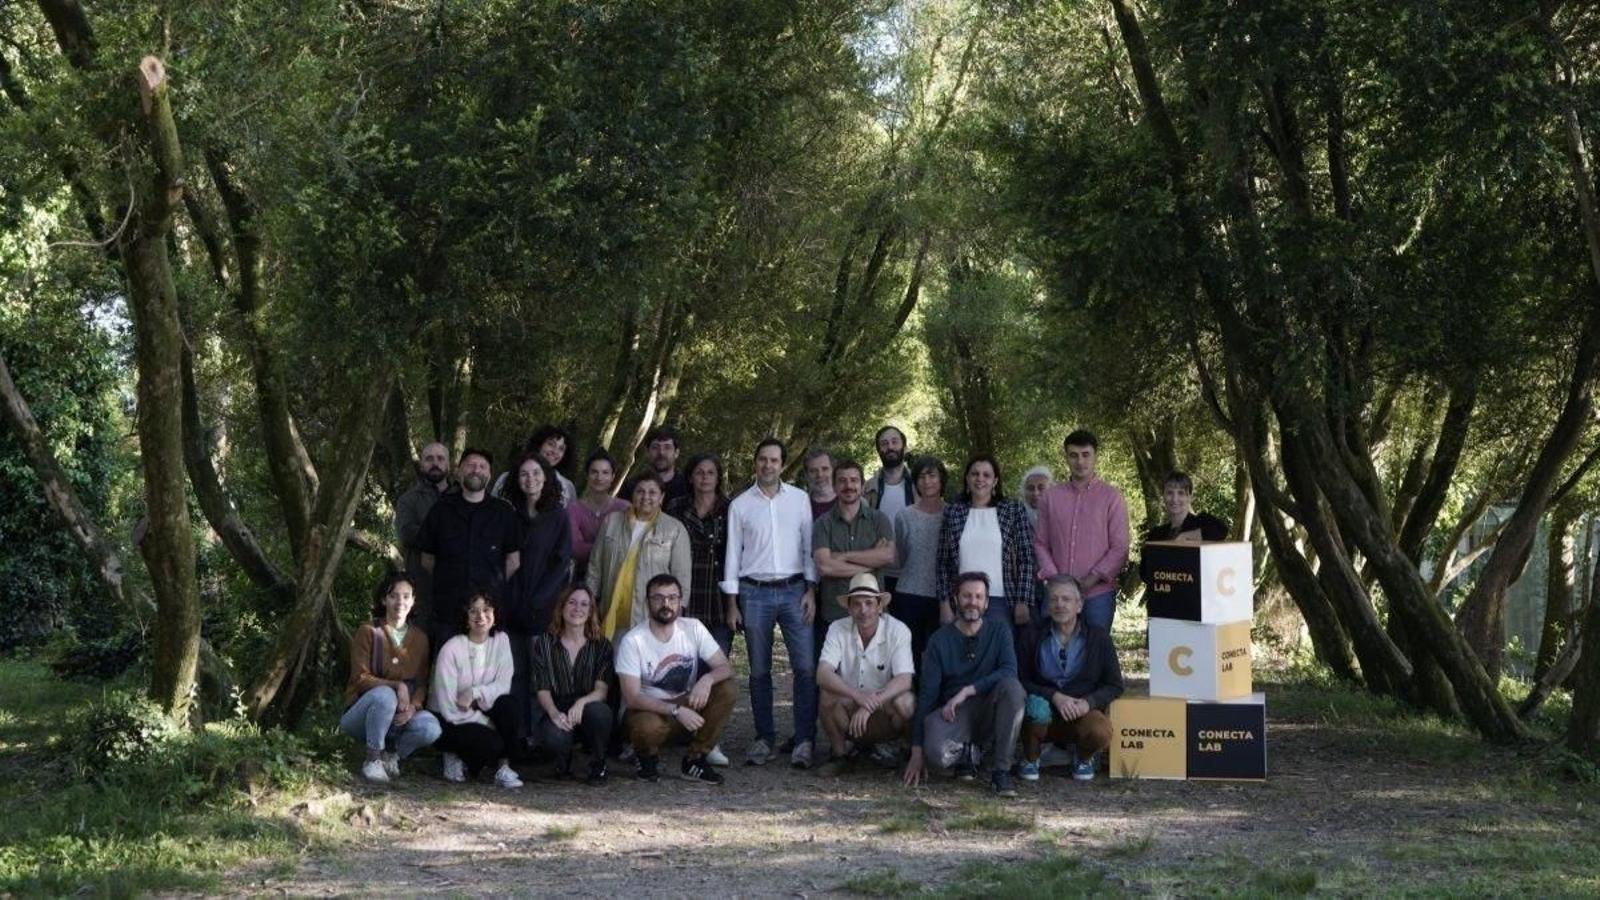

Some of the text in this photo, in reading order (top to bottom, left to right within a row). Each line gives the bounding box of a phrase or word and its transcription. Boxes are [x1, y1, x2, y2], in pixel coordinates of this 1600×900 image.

[1154, 571, 1193, 583] CONECTA
[1217, 567, 1236, 597] C
[1154, 583, 1171, 593] LAB
[1222, 648, 1247, 661] CONECTA
[1168, 646, 1193, 677] C
[1222, 662, 1233, 673] LAB
[1121, 728, 1175, 738] CONECTA
[1198, 730, 1253, 740] CONECTA
[1121, 740, 1144, 749] LAB
[1198, 742, 1222, 751] LAB
